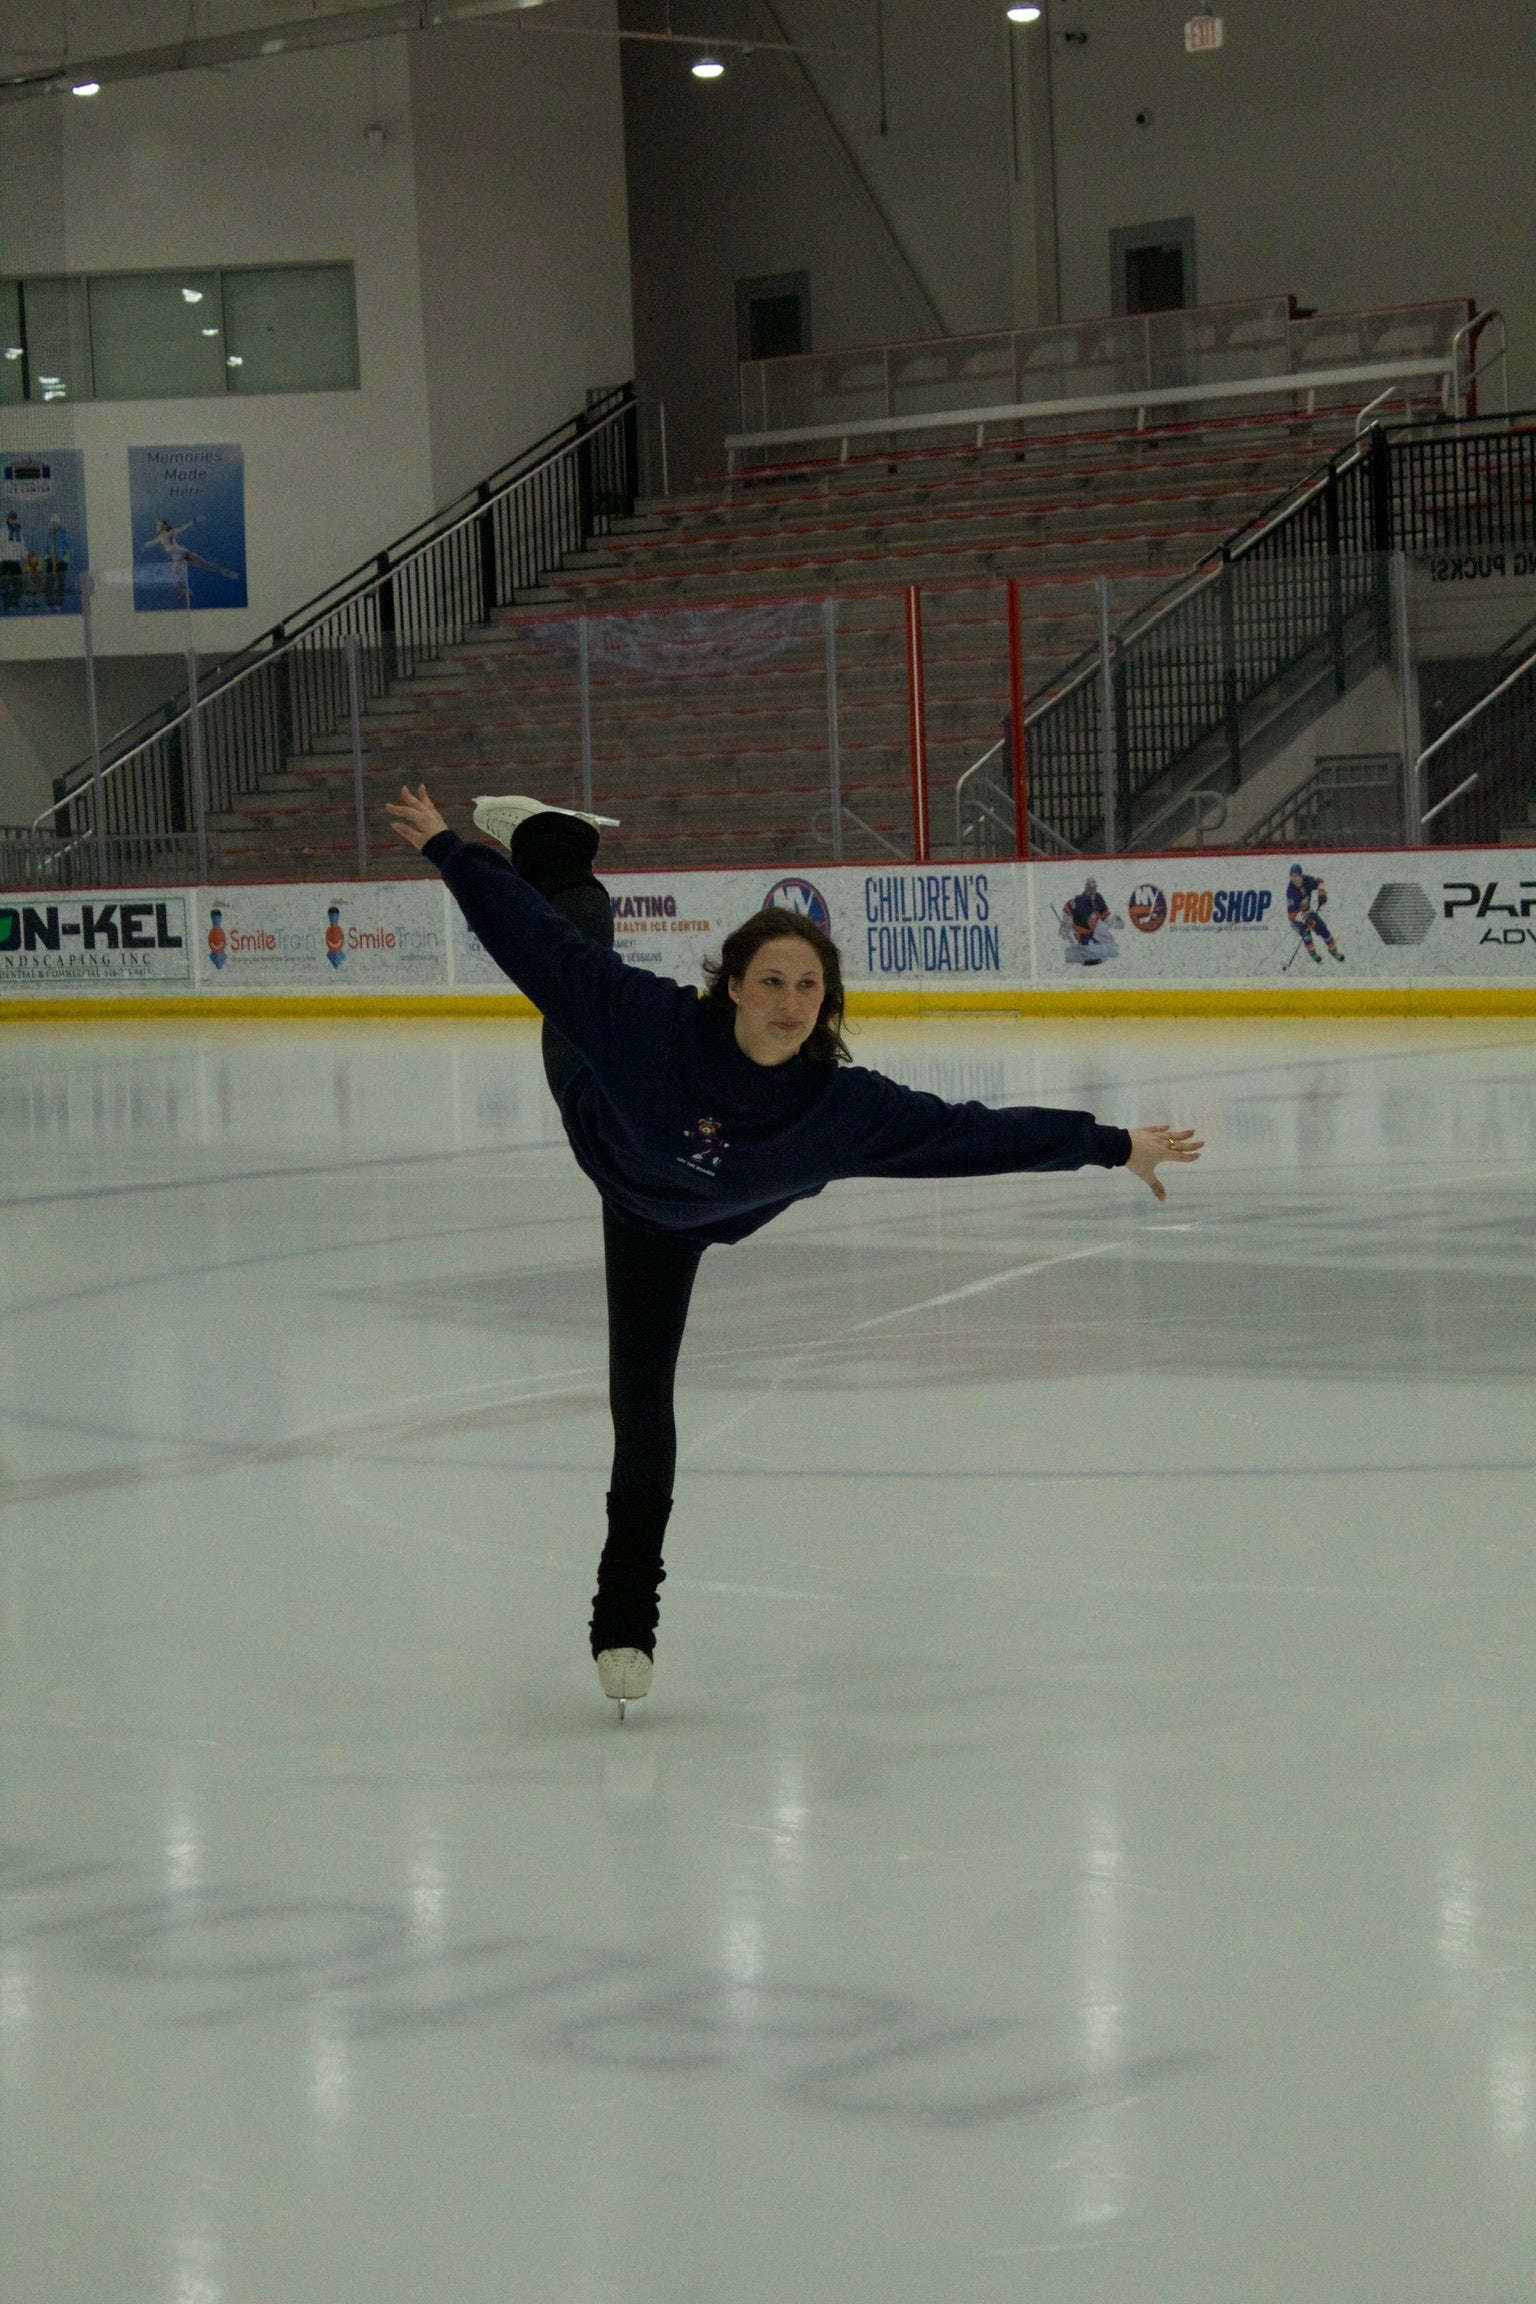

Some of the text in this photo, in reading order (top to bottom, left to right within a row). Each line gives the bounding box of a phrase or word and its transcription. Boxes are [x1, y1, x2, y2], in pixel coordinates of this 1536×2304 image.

[1191, 19, 1216, 48] EXIT
[147, 451, 222, 464] Memories
[164, 467, 207, 481] Made
[169, 485, 204, 497] Here
[865, 874, 990, 922] CHILDREN'S
[614, 921, 710, 932] EALTH ICE CENTER
[867, 925, 1001, 971] FOUNDATION
[121, 952, 152, 965] INC
